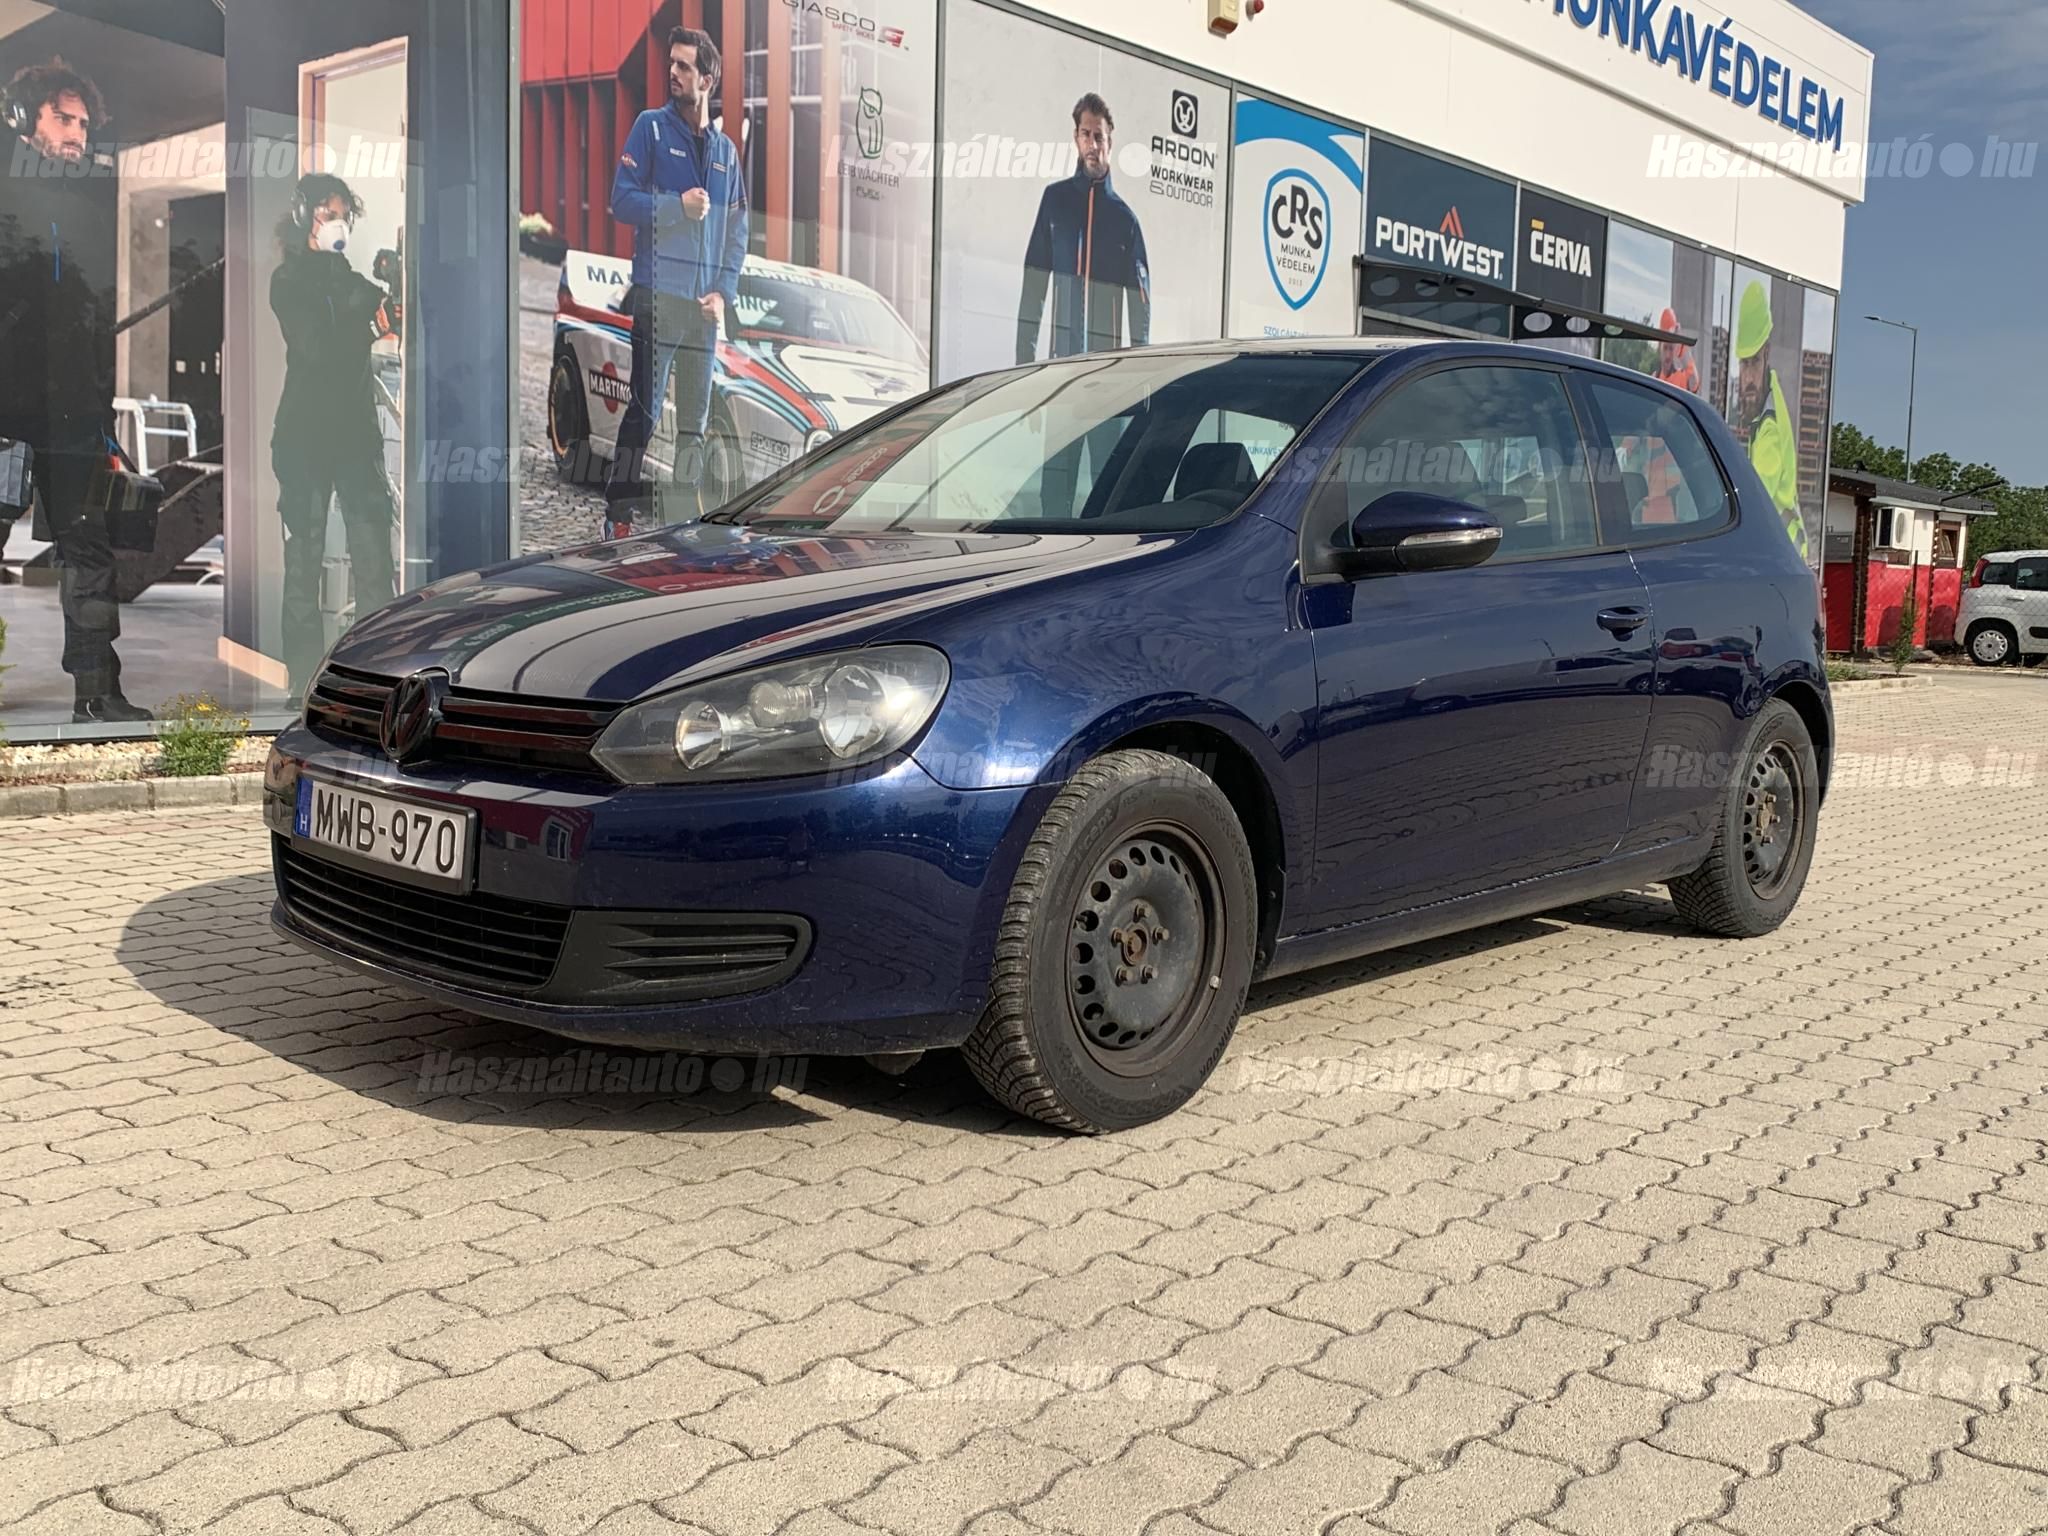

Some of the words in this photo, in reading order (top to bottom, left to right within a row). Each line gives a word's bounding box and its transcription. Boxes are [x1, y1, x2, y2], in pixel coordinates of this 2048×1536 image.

[1552, 0, 1844, 152] NKAVÉDELEM
[1151, 135, 1215, 170] ARDON
[1151, 164, 1214, 194] WORKWEAR
[1166, 184, 1214, 209] OUTDOOR
[1272, 184, 1323, 250] CRS
[1280, 242, 1312, 260] MUNKA
[1375, 215, 1504, 280] PORTWEST
[586, 265, 632, 284] MA
[1276, 254, 1316, 275] VÉDELEM
[752, 433, 789, 457] sparco
[300, 813, 308, 832] H
[315, 789, 457, 873] MWB-970
